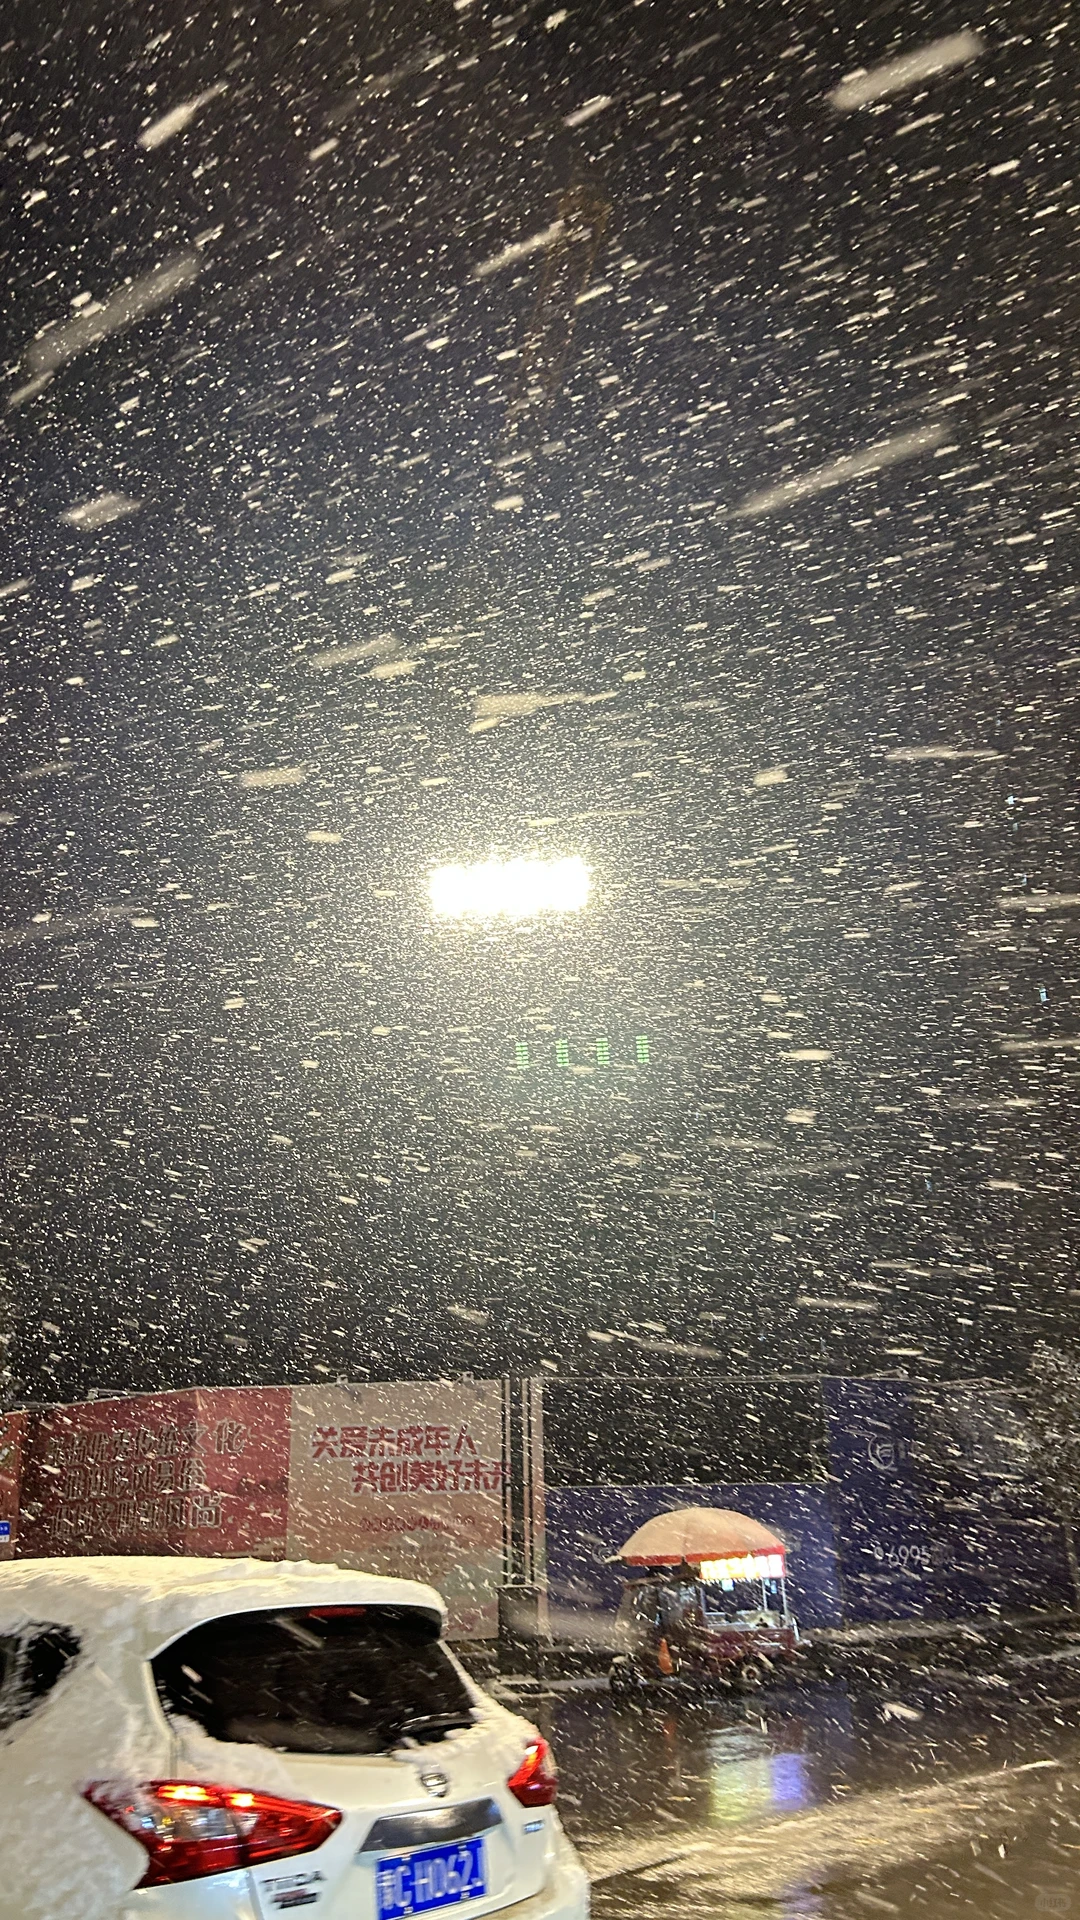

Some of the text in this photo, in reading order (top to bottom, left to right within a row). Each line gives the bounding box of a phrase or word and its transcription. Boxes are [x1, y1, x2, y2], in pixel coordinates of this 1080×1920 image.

[312, 1424, 477, 1459] 关爱未成年人
